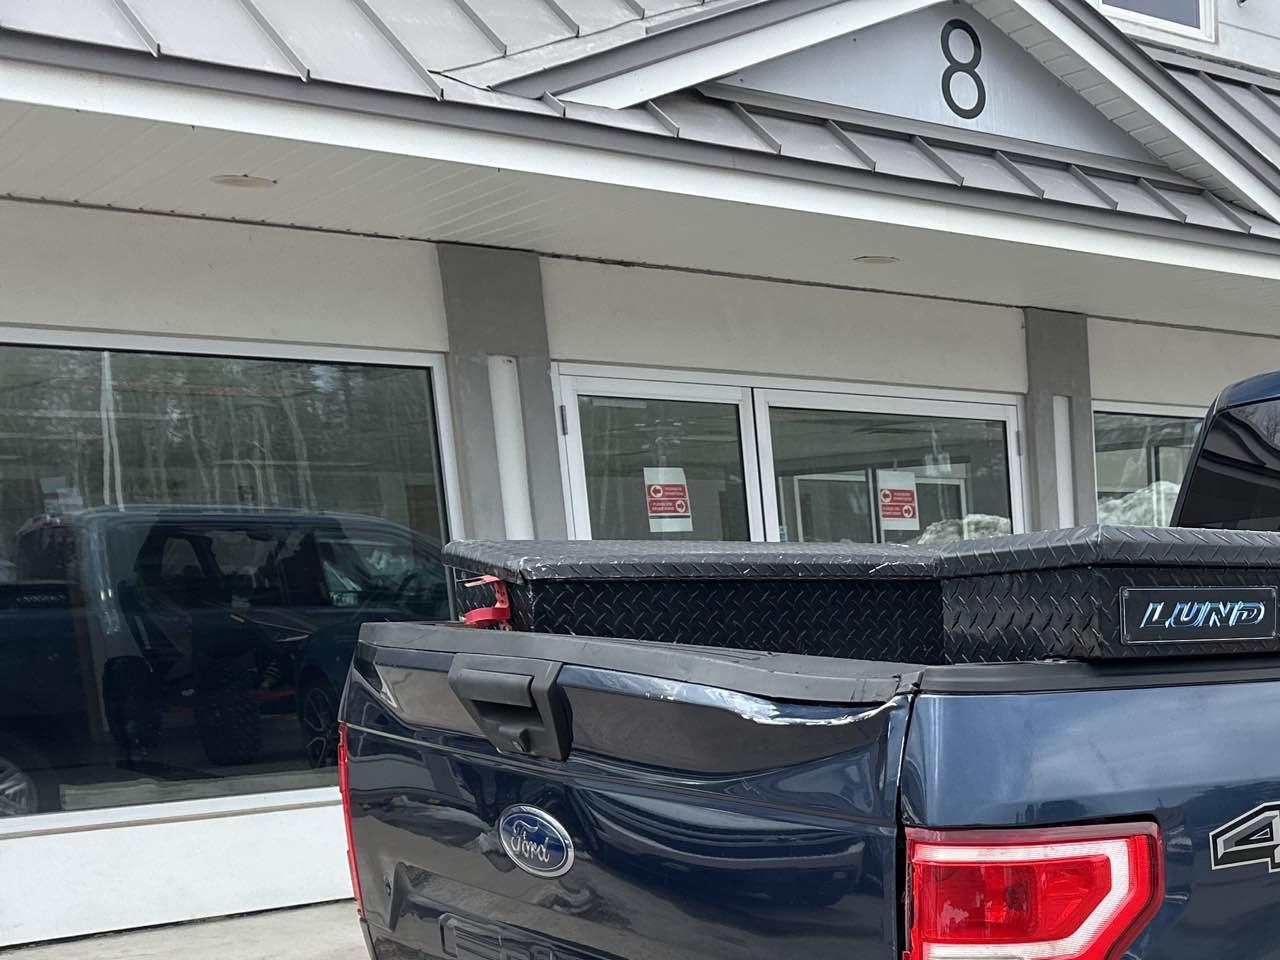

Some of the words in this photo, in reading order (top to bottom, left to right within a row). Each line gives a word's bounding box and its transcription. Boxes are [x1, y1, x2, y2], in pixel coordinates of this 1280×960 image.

[940, 18, 986, 120] 8
[1140, 600, 1266, 629] LUND
[510, 819, 550, 863] Ford
